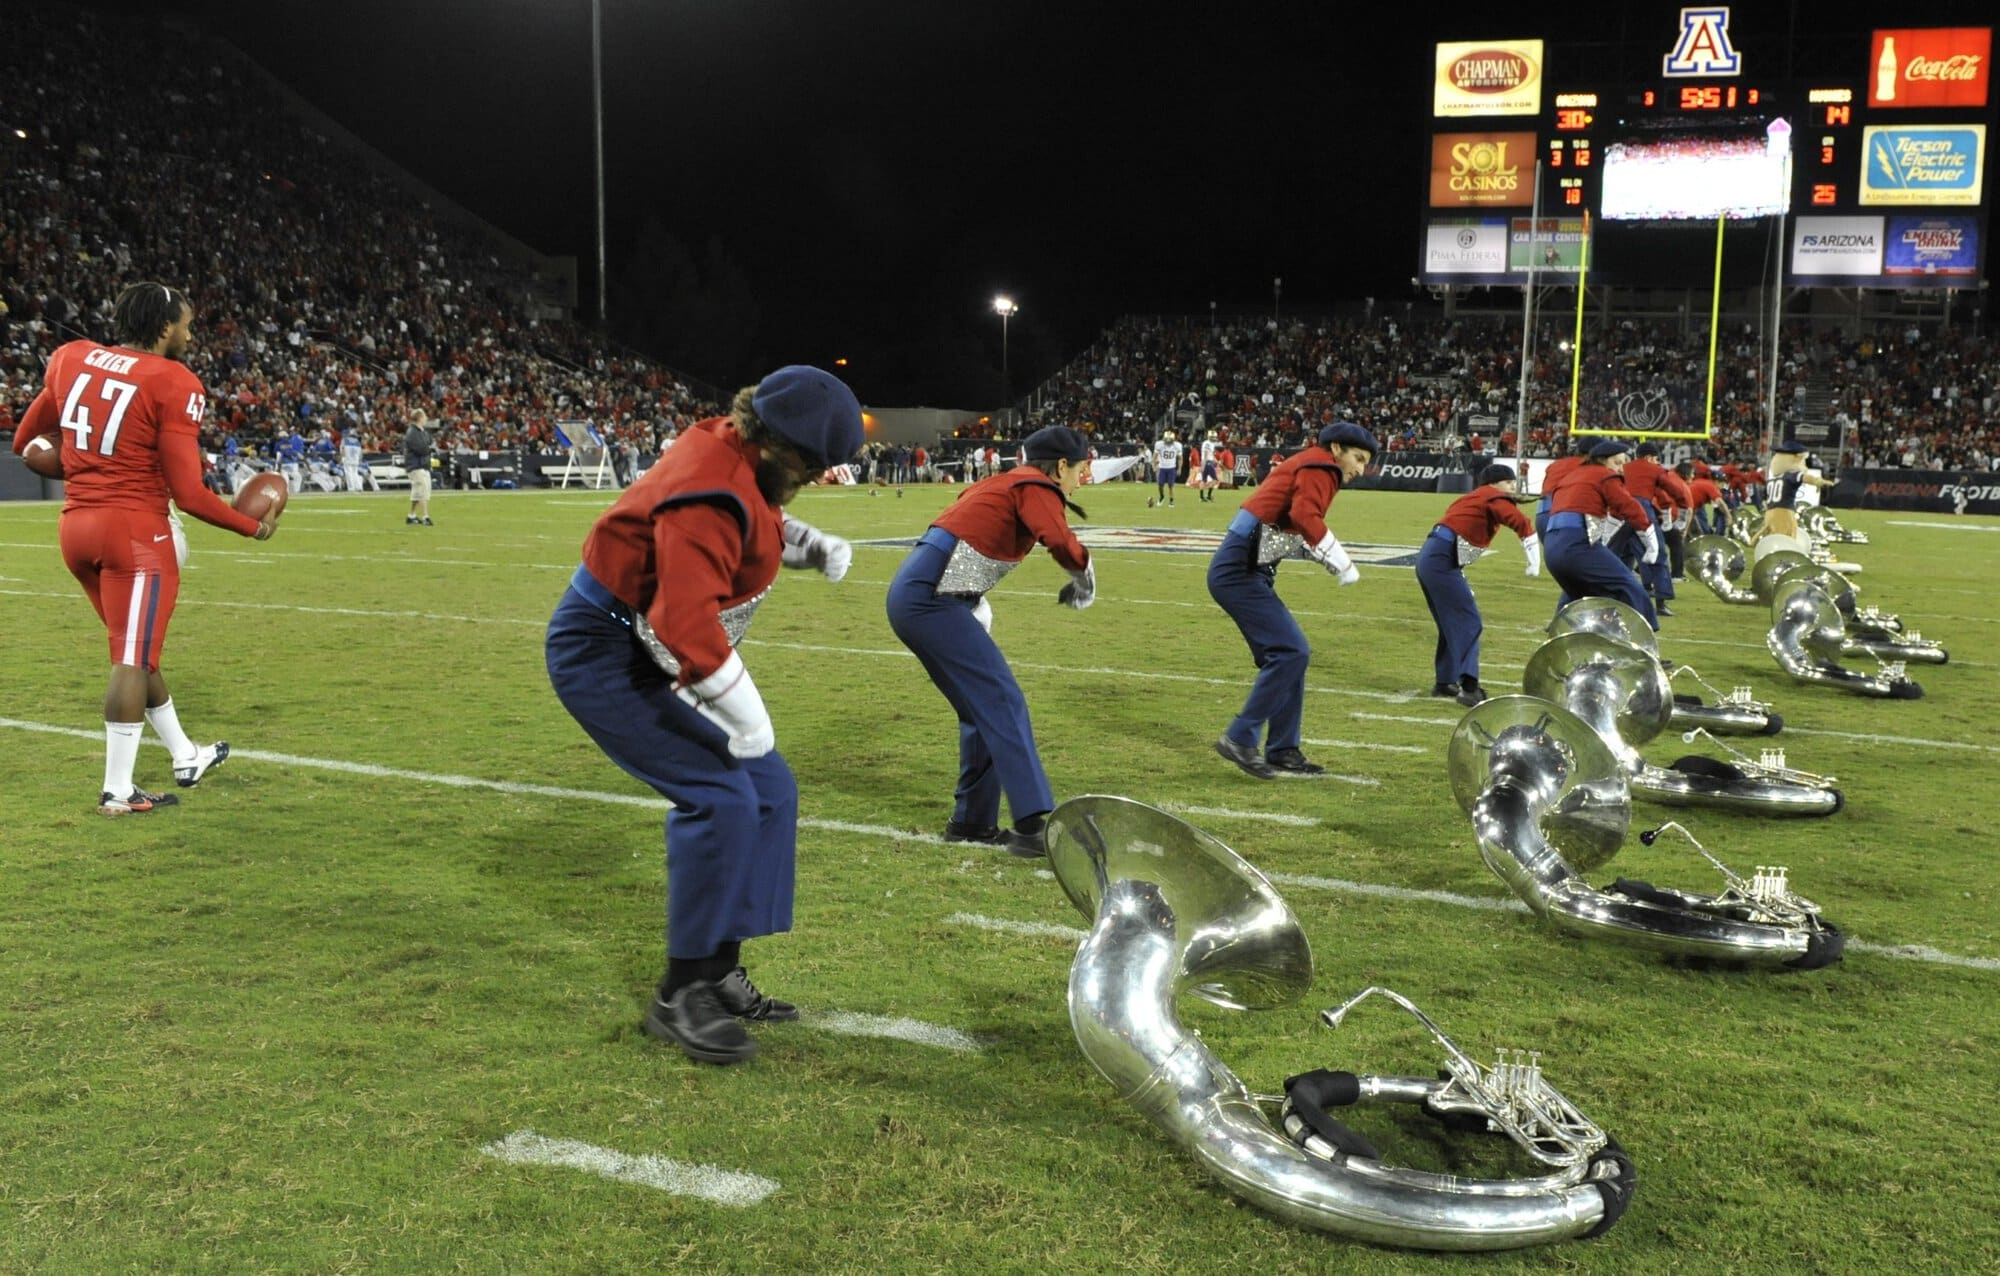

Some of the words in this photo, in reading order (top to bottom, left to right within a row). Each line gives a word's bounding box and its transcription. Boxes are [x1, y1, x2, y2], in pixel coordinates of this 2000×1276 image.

[1663, 6, 1742, 77] A
[1455, 59, 1521, 78] CHAPMAN
[1456, 78, 1520, 87] AUTOMOTIVE
[1644, 90, 1654, 106] 3
[1680, 86, 1737, 109] 5:51
[1748, 89, 1759, 104] 3
[1557, 110, 1586, 129] 30
[1826, 105, 1850, 125] 14
[1896, 136, 1952, 153] Tucson
[1450, 142, 1518, 176] SOL
[1551, 150, 1562, 166] 3
[1575, 150, 1590, 166] 12
[1821, 147, 1833, 164] 3
[1901, 152, 1967, 167] Electric
[1906, 168, 1965, 182] Power
[1449, 176, 1518, 191] CASINOS
[1812, 184, 1836, 203] 25
[1512, 233, 1530, 242] CAR
[1819, 235, 1875, 246] ARIZONA
[1904, 230, 1960, 240] ENERGY
[1917, 239, 1958, 248] DRINK
[60, 373, 137, 456] 47
[1163, 450, 1175, 460] 60
